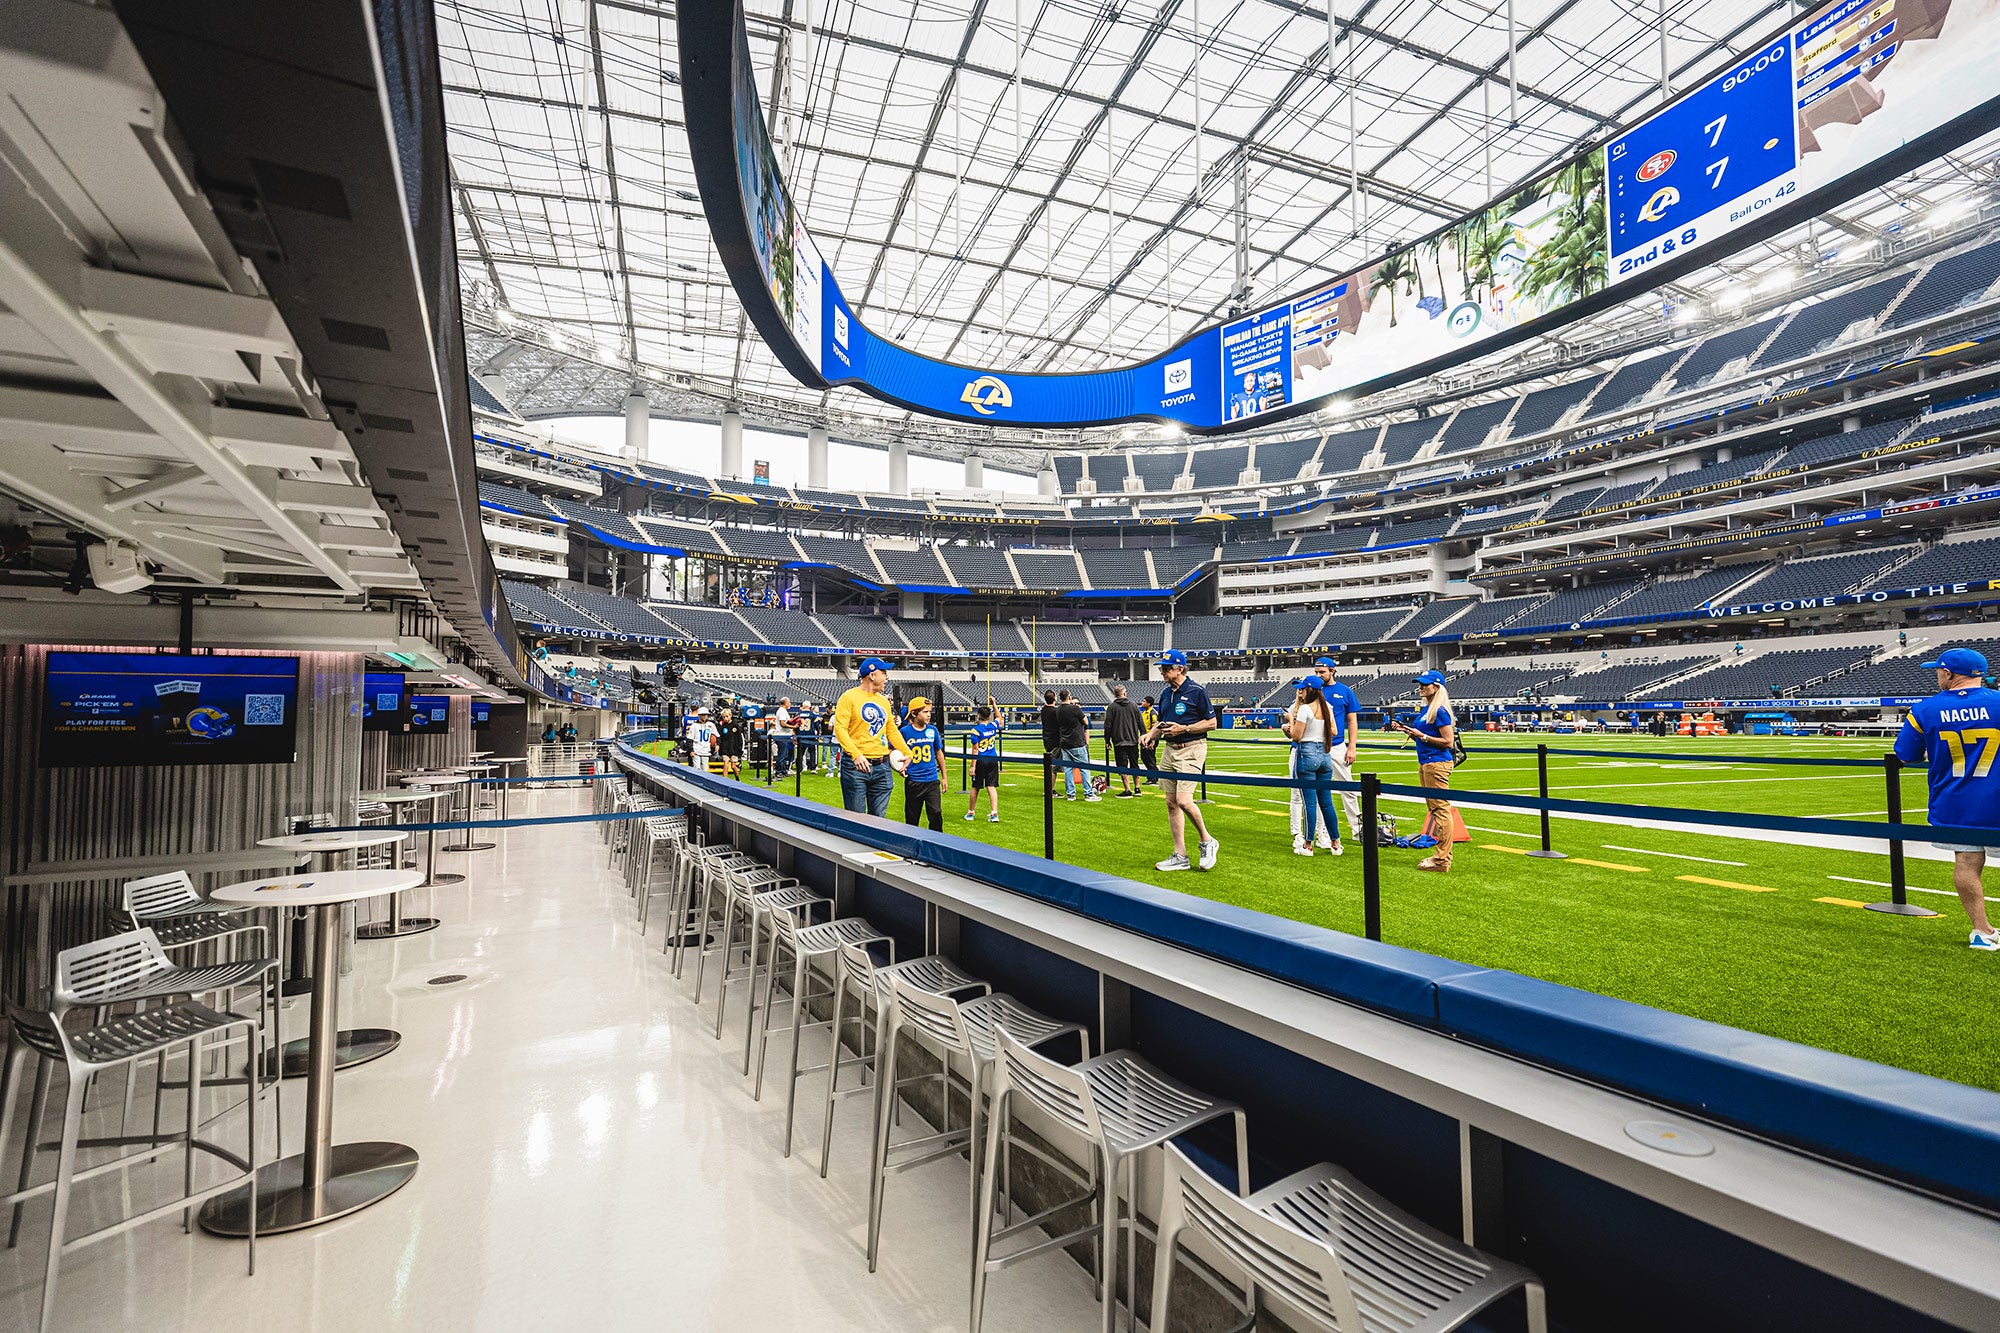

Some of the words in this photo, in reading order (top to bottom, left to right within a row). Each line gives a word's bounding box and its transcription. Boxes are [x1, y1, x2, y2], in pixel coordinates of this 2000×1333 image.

[1802, 38, 1837, 64] Stafford
[1874, 9, 1880, 20] 5
[1874, 32, 1883, 40] 4
[1722, 46, 1784, 92] 90:00
[1875, 53, 1884, 62] 4
[1704, 114, 1728, 148] 7
[1706, 156, 1729, 190] 7
[1730, 205, 1751, 222] Ball
[1754, 197, 1771, 210] On
[1775, 182, 1796, 198] 42
[1620, 246, 1657, 274] 2nd
[1662, 239, 1676, 254] &
[1681, 228, 1697, 245] 8
[1230, 340, 1256, 353] MANAGE
[1257, 330, 1284, 344] TICKETS
[1232, 347, 1257, 360] IN-GAME
[1258, 338, 1283, 351] ALERTS
[832, 343, 850, 368] TOYOTA
[1232, 353, 1262, 367] BREAKING
[1263, 346, 1282, 358] NEWS
[1160, 393, 1196, 408] TOYOTA
[1242, 398, 1257, 416] 10
[1456, 466, 1514, 481] WELCOME
[1569, 441, 1611, 455] ROYAL
[1618, 429, 1655, 442] TOUR
[1904, 437, 1941, 449] TOUR
[1838, 514, 1866, 522] RAMS
[1709, 596, 1836, 618] WELCOME
[1851, 591, 1888, 603] TO
[1906, 583, 1968, 598] THE
[542, 625, 606, 639] WELCOME
[612, 633, 628, 641] TO
[635, 636, 660, 644] THE
[666, 639, 708, 648] ROYAL
[714, 642, 749, 650] TOUR
[1940, 707, 1989, 723] NACUA
[912, 744, 931, 764] 99
[1939, 728, 2000, 778] 17
